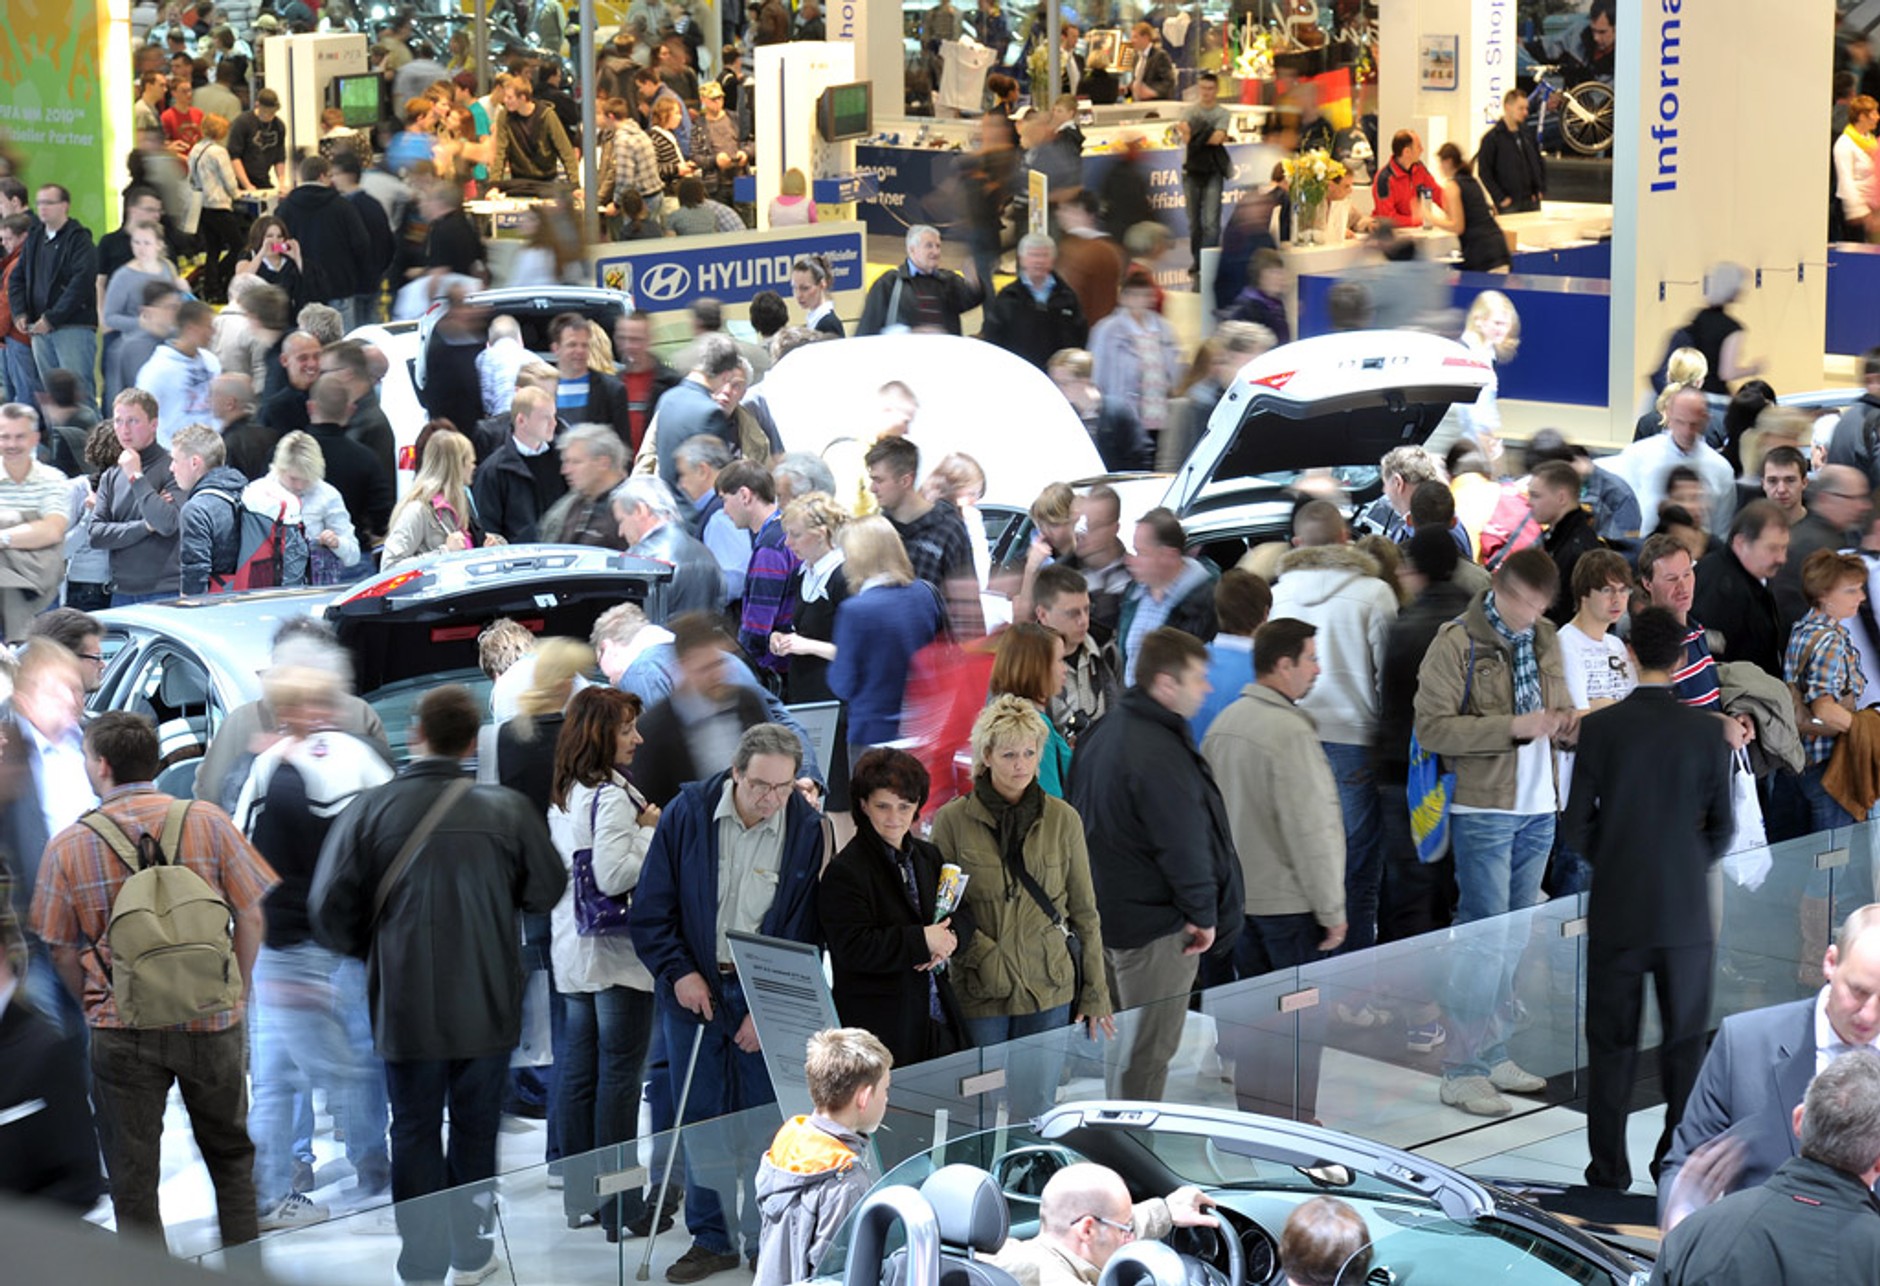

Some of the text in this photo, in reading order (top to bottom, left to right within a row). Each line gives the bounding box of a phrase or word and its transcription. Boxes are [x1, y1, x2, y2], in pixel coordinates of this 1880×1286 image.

[1486, 1, 1505, 65] Sho
[1150, 169, 1179, 186] FIFA
[698, 252, 818, 292] HYUND
